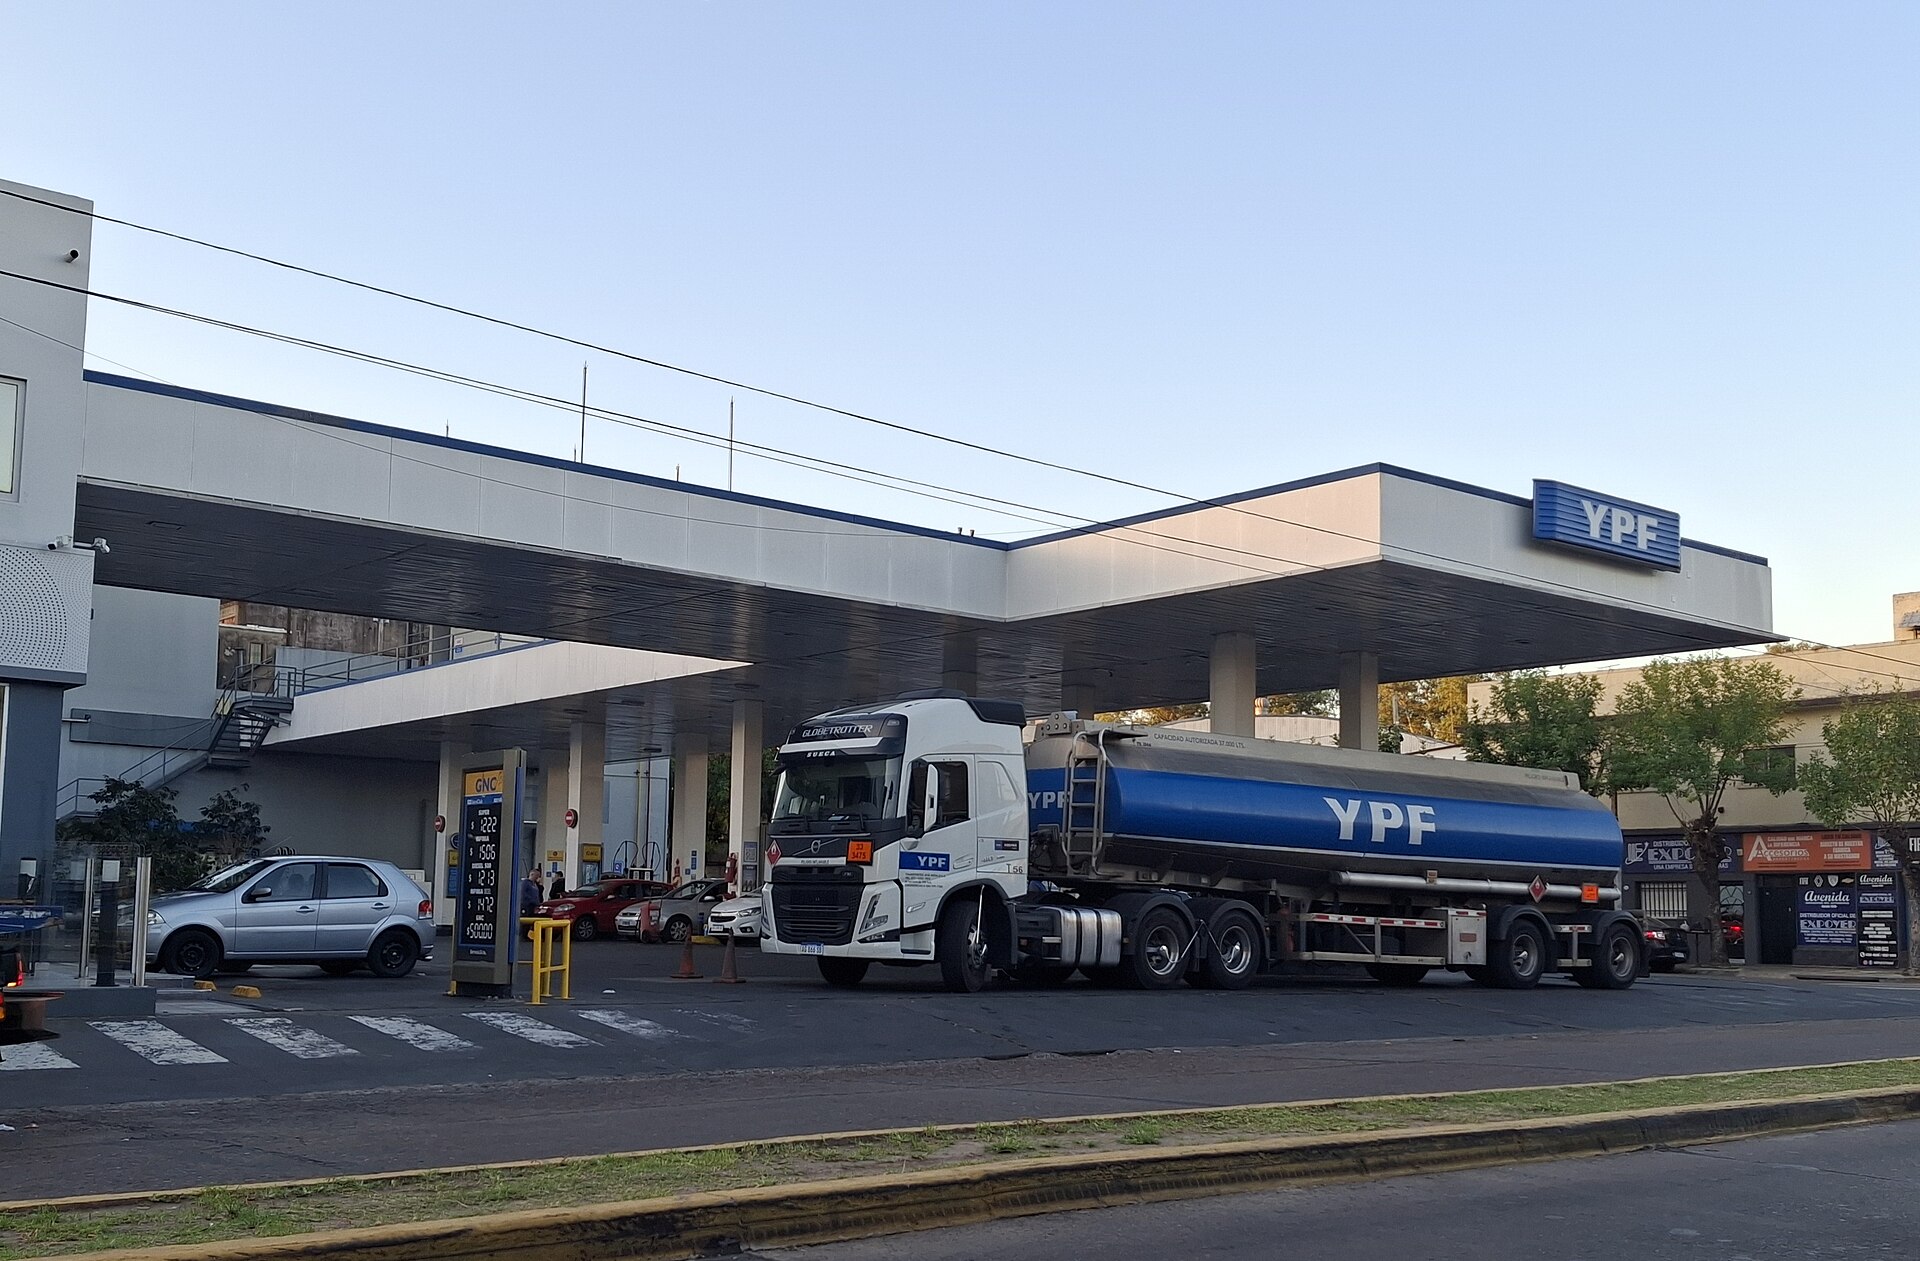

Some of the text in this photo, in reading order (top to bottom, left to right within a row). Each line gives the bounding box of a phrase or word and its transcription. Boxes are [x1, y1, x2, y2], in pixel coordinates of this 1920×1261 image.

[1581, 500, 1658, 550] YPF
[802, 725, 873, 737] GLOBETROTTER
[1153, 733, 1184, 742] CAPACIDAD
[1185, 736, 1217, 745] AUTORIZADA
[806, 750, 836, 758] SUECA
[475, 777, 497, 792] GNC
[471, 816, 497, 832] $ 1222
[1323, 797, 1436, 845] YPF
[469, 844, 496, 860] $ 1506
[917, 856, 947, 868] YPF
[1012, 866, 1023, 874] 56
[468, 870, 495, 886] $ 1213
[1860, 874, 1893, 883] Avenida
[1805, 891, 1850, 902] Avenida
[467, 896, 494, 913] $ 1472
[1800, 920, 1856, 929] EXPOYER
